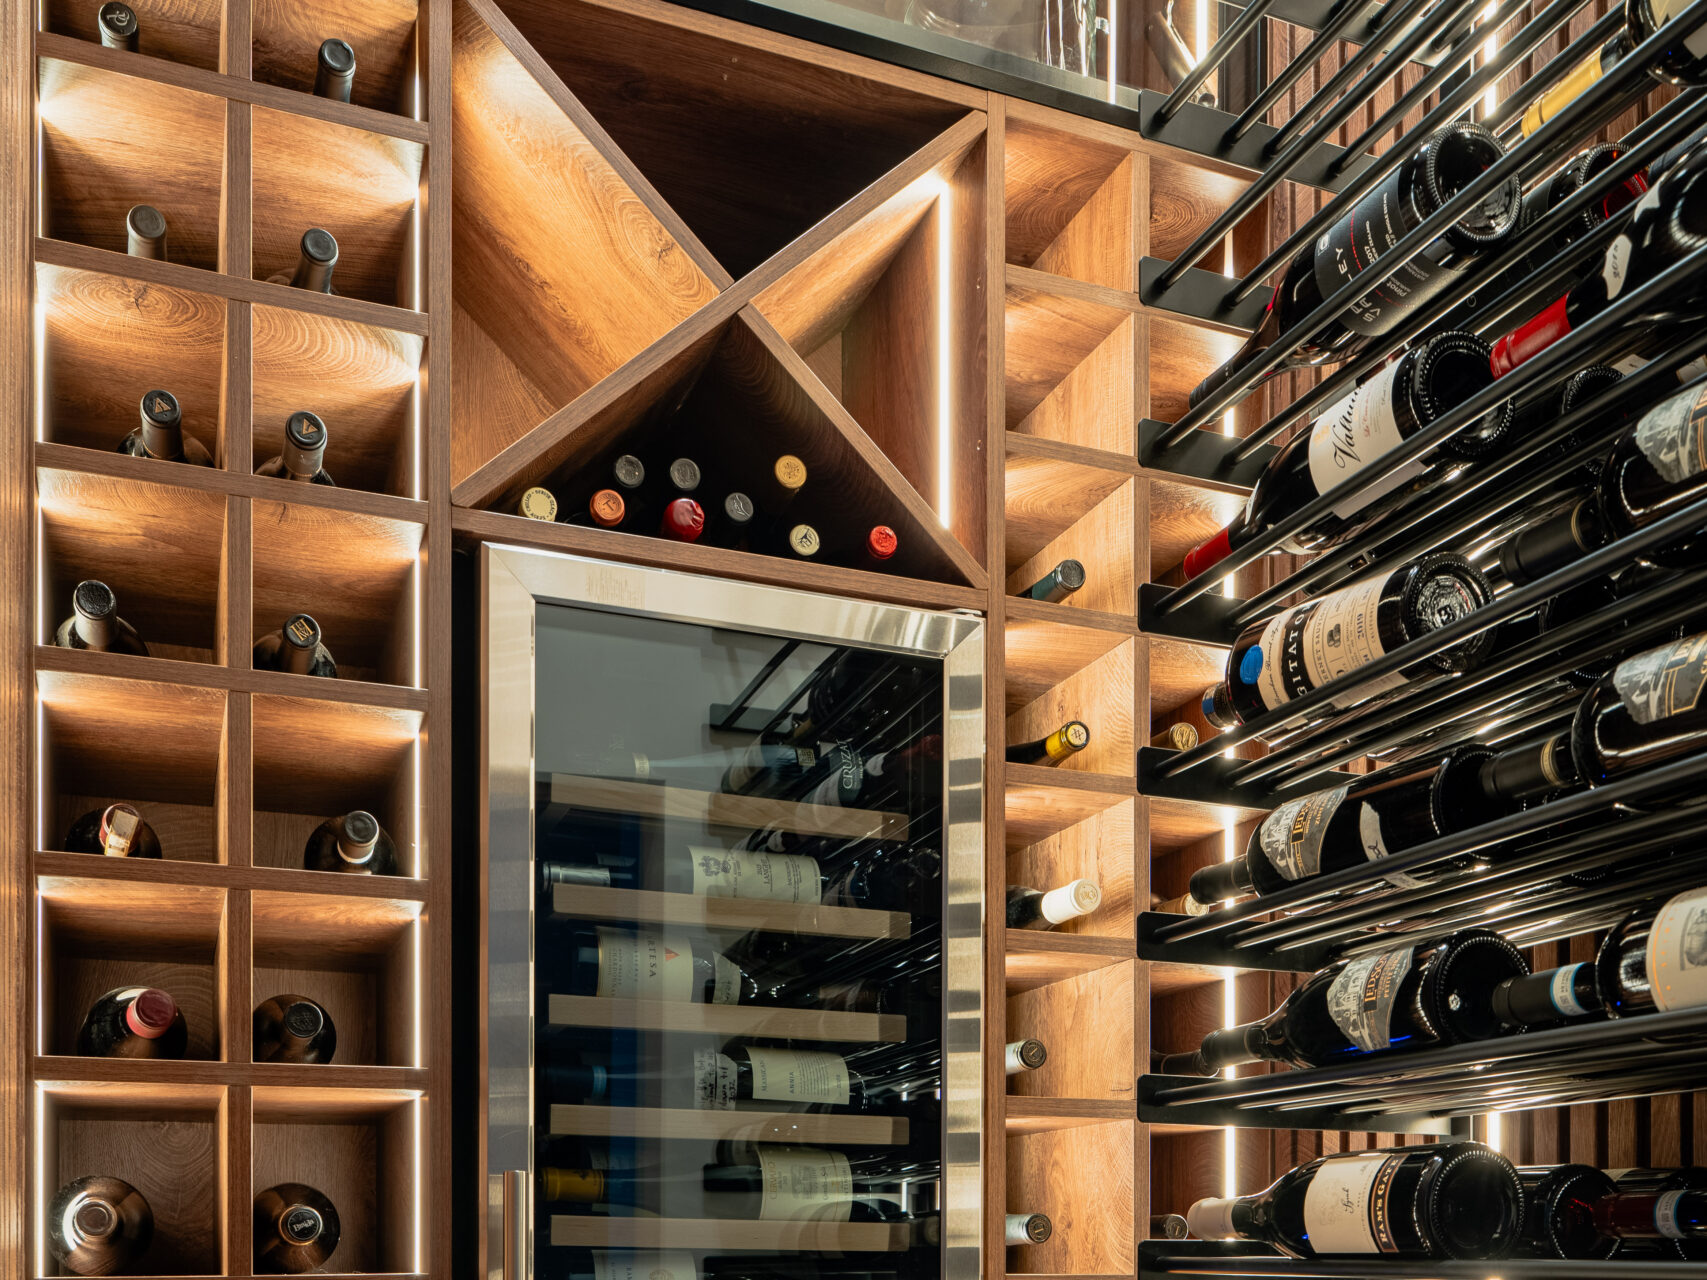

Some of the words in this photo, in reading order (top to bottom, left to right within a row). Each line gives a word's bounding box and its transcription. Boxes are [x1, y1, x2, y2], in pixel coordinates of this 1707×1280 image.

[1351, 302, 1377, 322] SP
[1377, 1159, 1399, 1196] GATE
[1375, 1198, 1388, 1243] RAM'S
